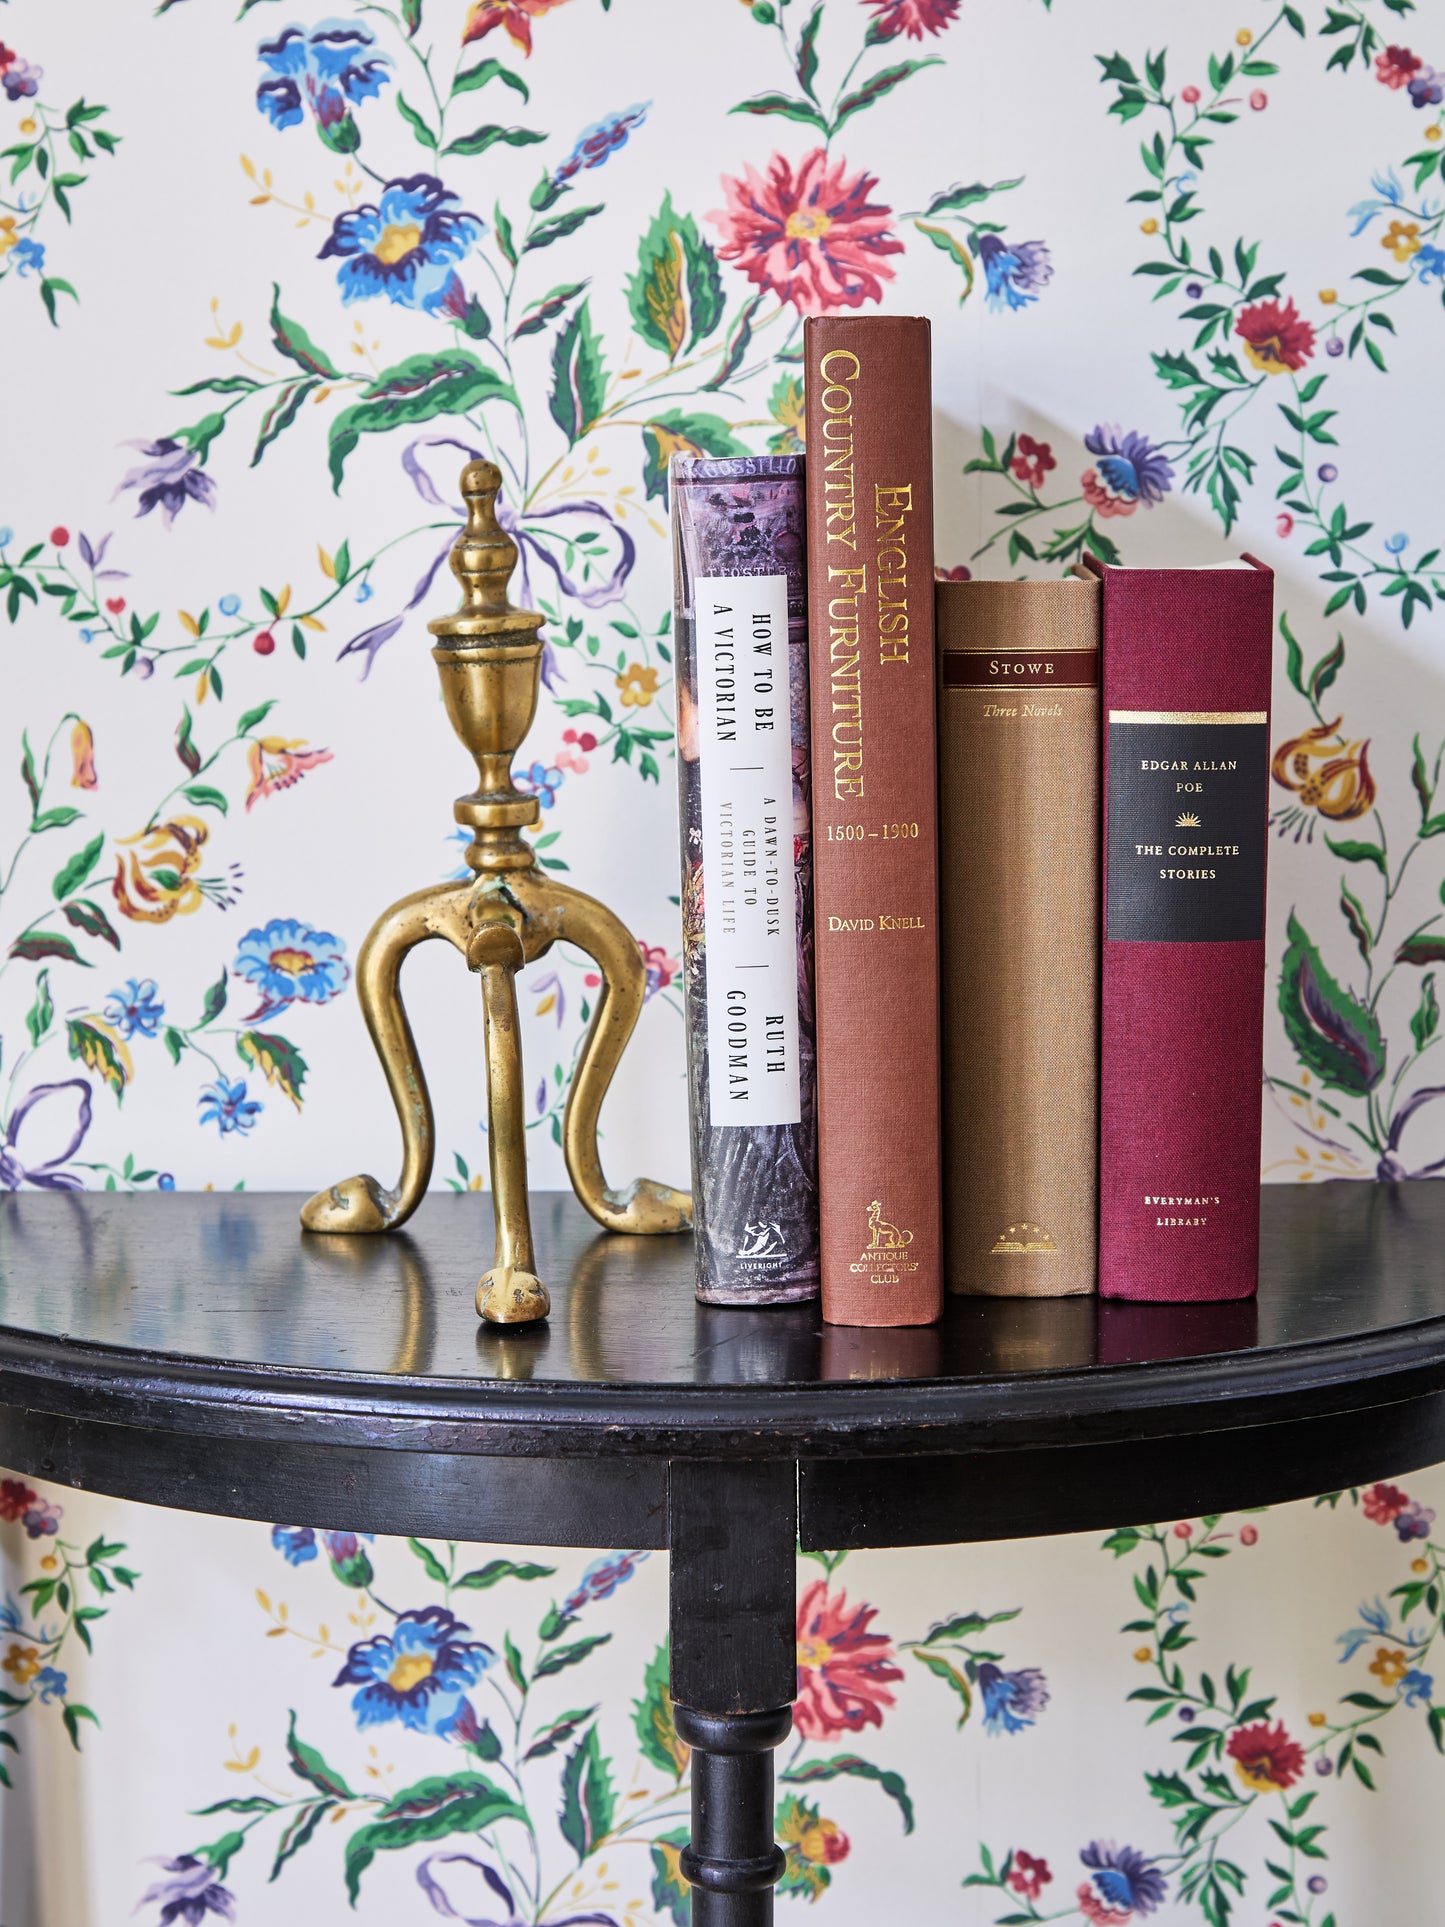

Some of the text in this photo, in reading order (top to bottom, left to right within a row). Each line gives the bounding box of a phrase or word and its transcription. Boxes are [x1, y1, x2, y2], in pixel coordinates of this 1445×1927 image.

[819, 349, 867, 802] COUNTRY FURNITURE
[874, 483, 913, 666] ENGLISH
[713, 604, 737, 741] A VICTORIAN
[752, 613, 774, 731] HOW TO BE
[989, 660, 1054, 675] STOWE
[983, 703, 1064, 717] Three Novels
[1140, 759, 1237, 771] EDGAR ALLAN
[1176, 782, 1203, 793] POE
[1135, 844, 1240, 856] THE COMPLETE
[719, 802, 736, 934] VICTORIAN LIFE
[742, 829, 758, 905] GUIDE TO
[763, 797, 780, 936] A DAWN-TO-DUSK
[1159, 869, 1216, 880] STORIES
[827, 915, 926, 932] DAVID KNELL
[726, 990, 749, 1100] GOODMAN
[765, 1015, 786, 1073] RUTH
[1156, 1217, 1208, 1226] LIBRARY
[859, 1251, 909, 1262] ANTIQUE
[740, 1261, 783, 1270] LIVERIGHT
[870, 1274, 900, 1285] CLUB
